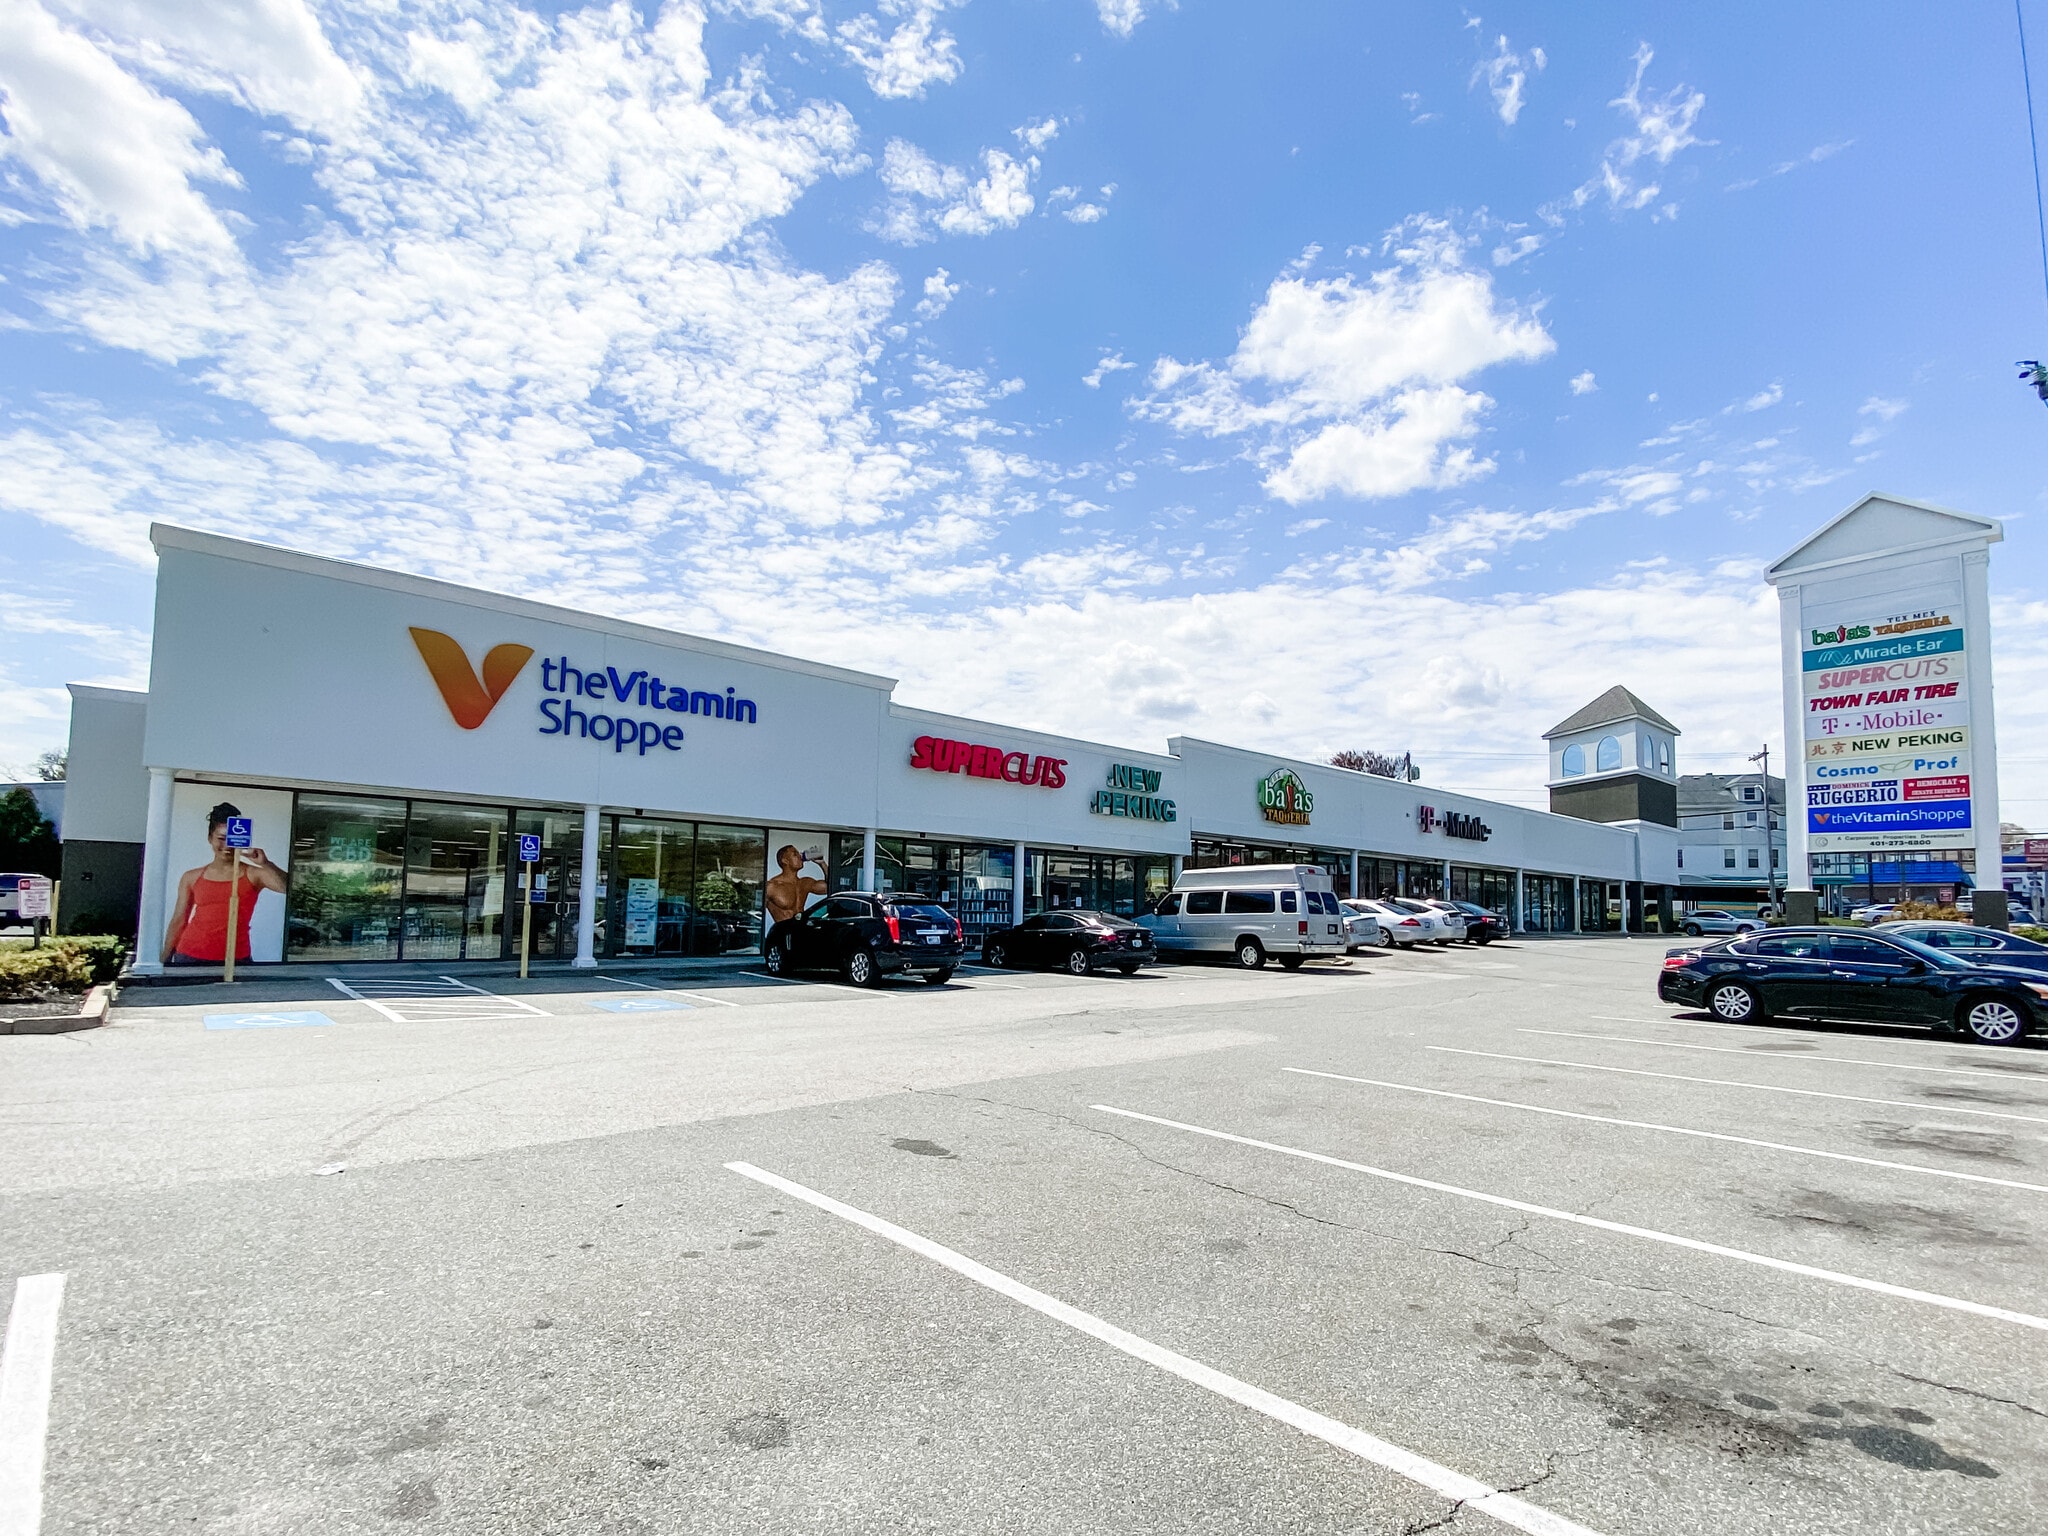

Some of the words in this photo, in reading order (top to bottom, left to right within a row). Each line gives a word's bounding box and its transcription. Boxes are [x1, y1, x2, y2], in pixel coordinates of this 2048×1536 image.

[1913, 611, 1936, 619] MEX
[1854, 640, 1944, 660] Miracle-Ear
[1818, 658, 1949, 690] SUPERCUTS
[1810, 693, 1863, 712] TOWN
[1865, 688, 1910, 705] FAIR
[1914, 682, 1959, 700] TIRE
[539, 698, 684, 756] Shoppe
[1852, 738, 1890, 751] NEW
[1898, 731, 1963, 747] PEKING
[910, 735, 1068, 789] SUPERCUTS
[1816, 765, 1879, 778] Cosmo
[1914, 756, 1958, 771] Prof
[1112, 763, 1162, 793] NEW
[1095, 790, 1177, 822] PEKING
[1808, 787, 1898, 806] RUGGERIO
[1266, 809, 1310, 825] TAQUERIA
